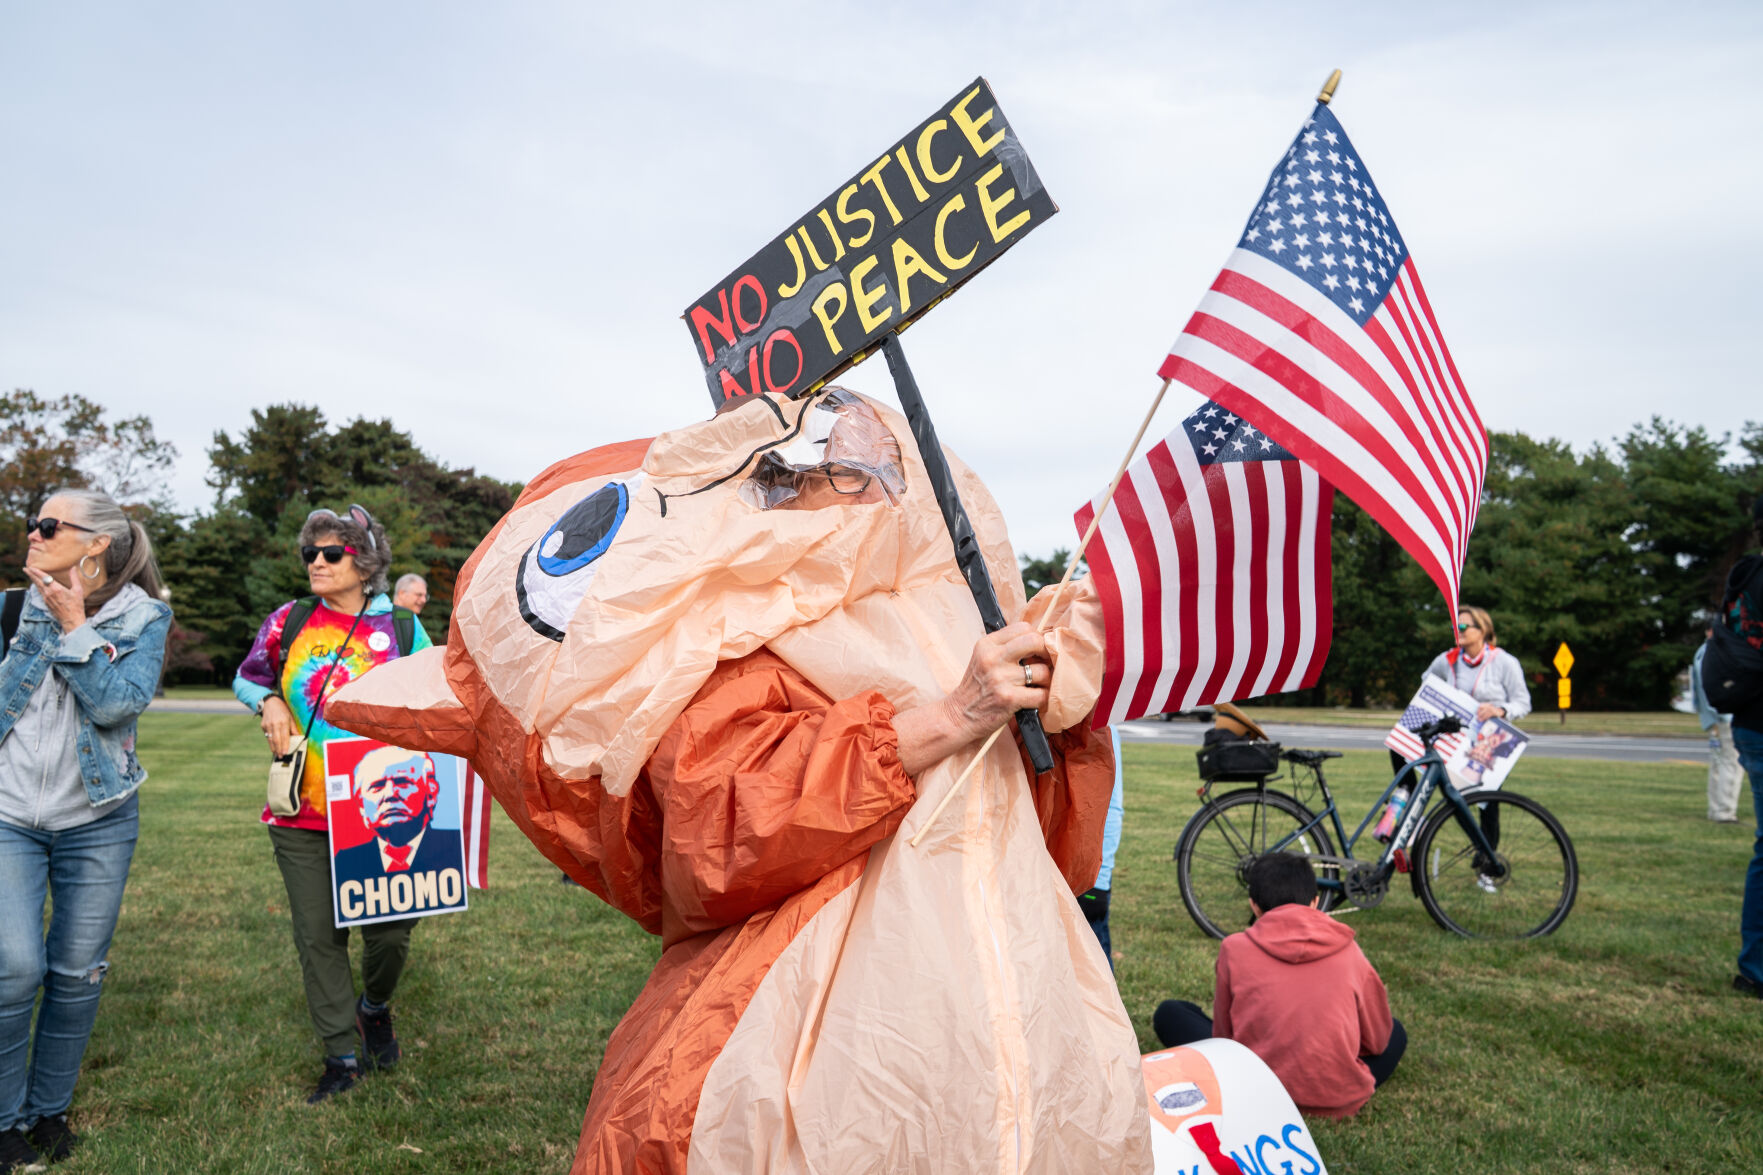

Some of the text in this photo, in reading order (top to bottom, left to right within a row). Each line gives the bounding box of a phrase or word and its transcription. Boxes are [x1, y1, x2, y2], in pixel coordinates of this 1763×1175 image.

[690, 85, 1006, 364] NO JUSTICE
[719, 163, 1031, 400] NO PEACE
[340, 868, 462, 919] CHOMO
